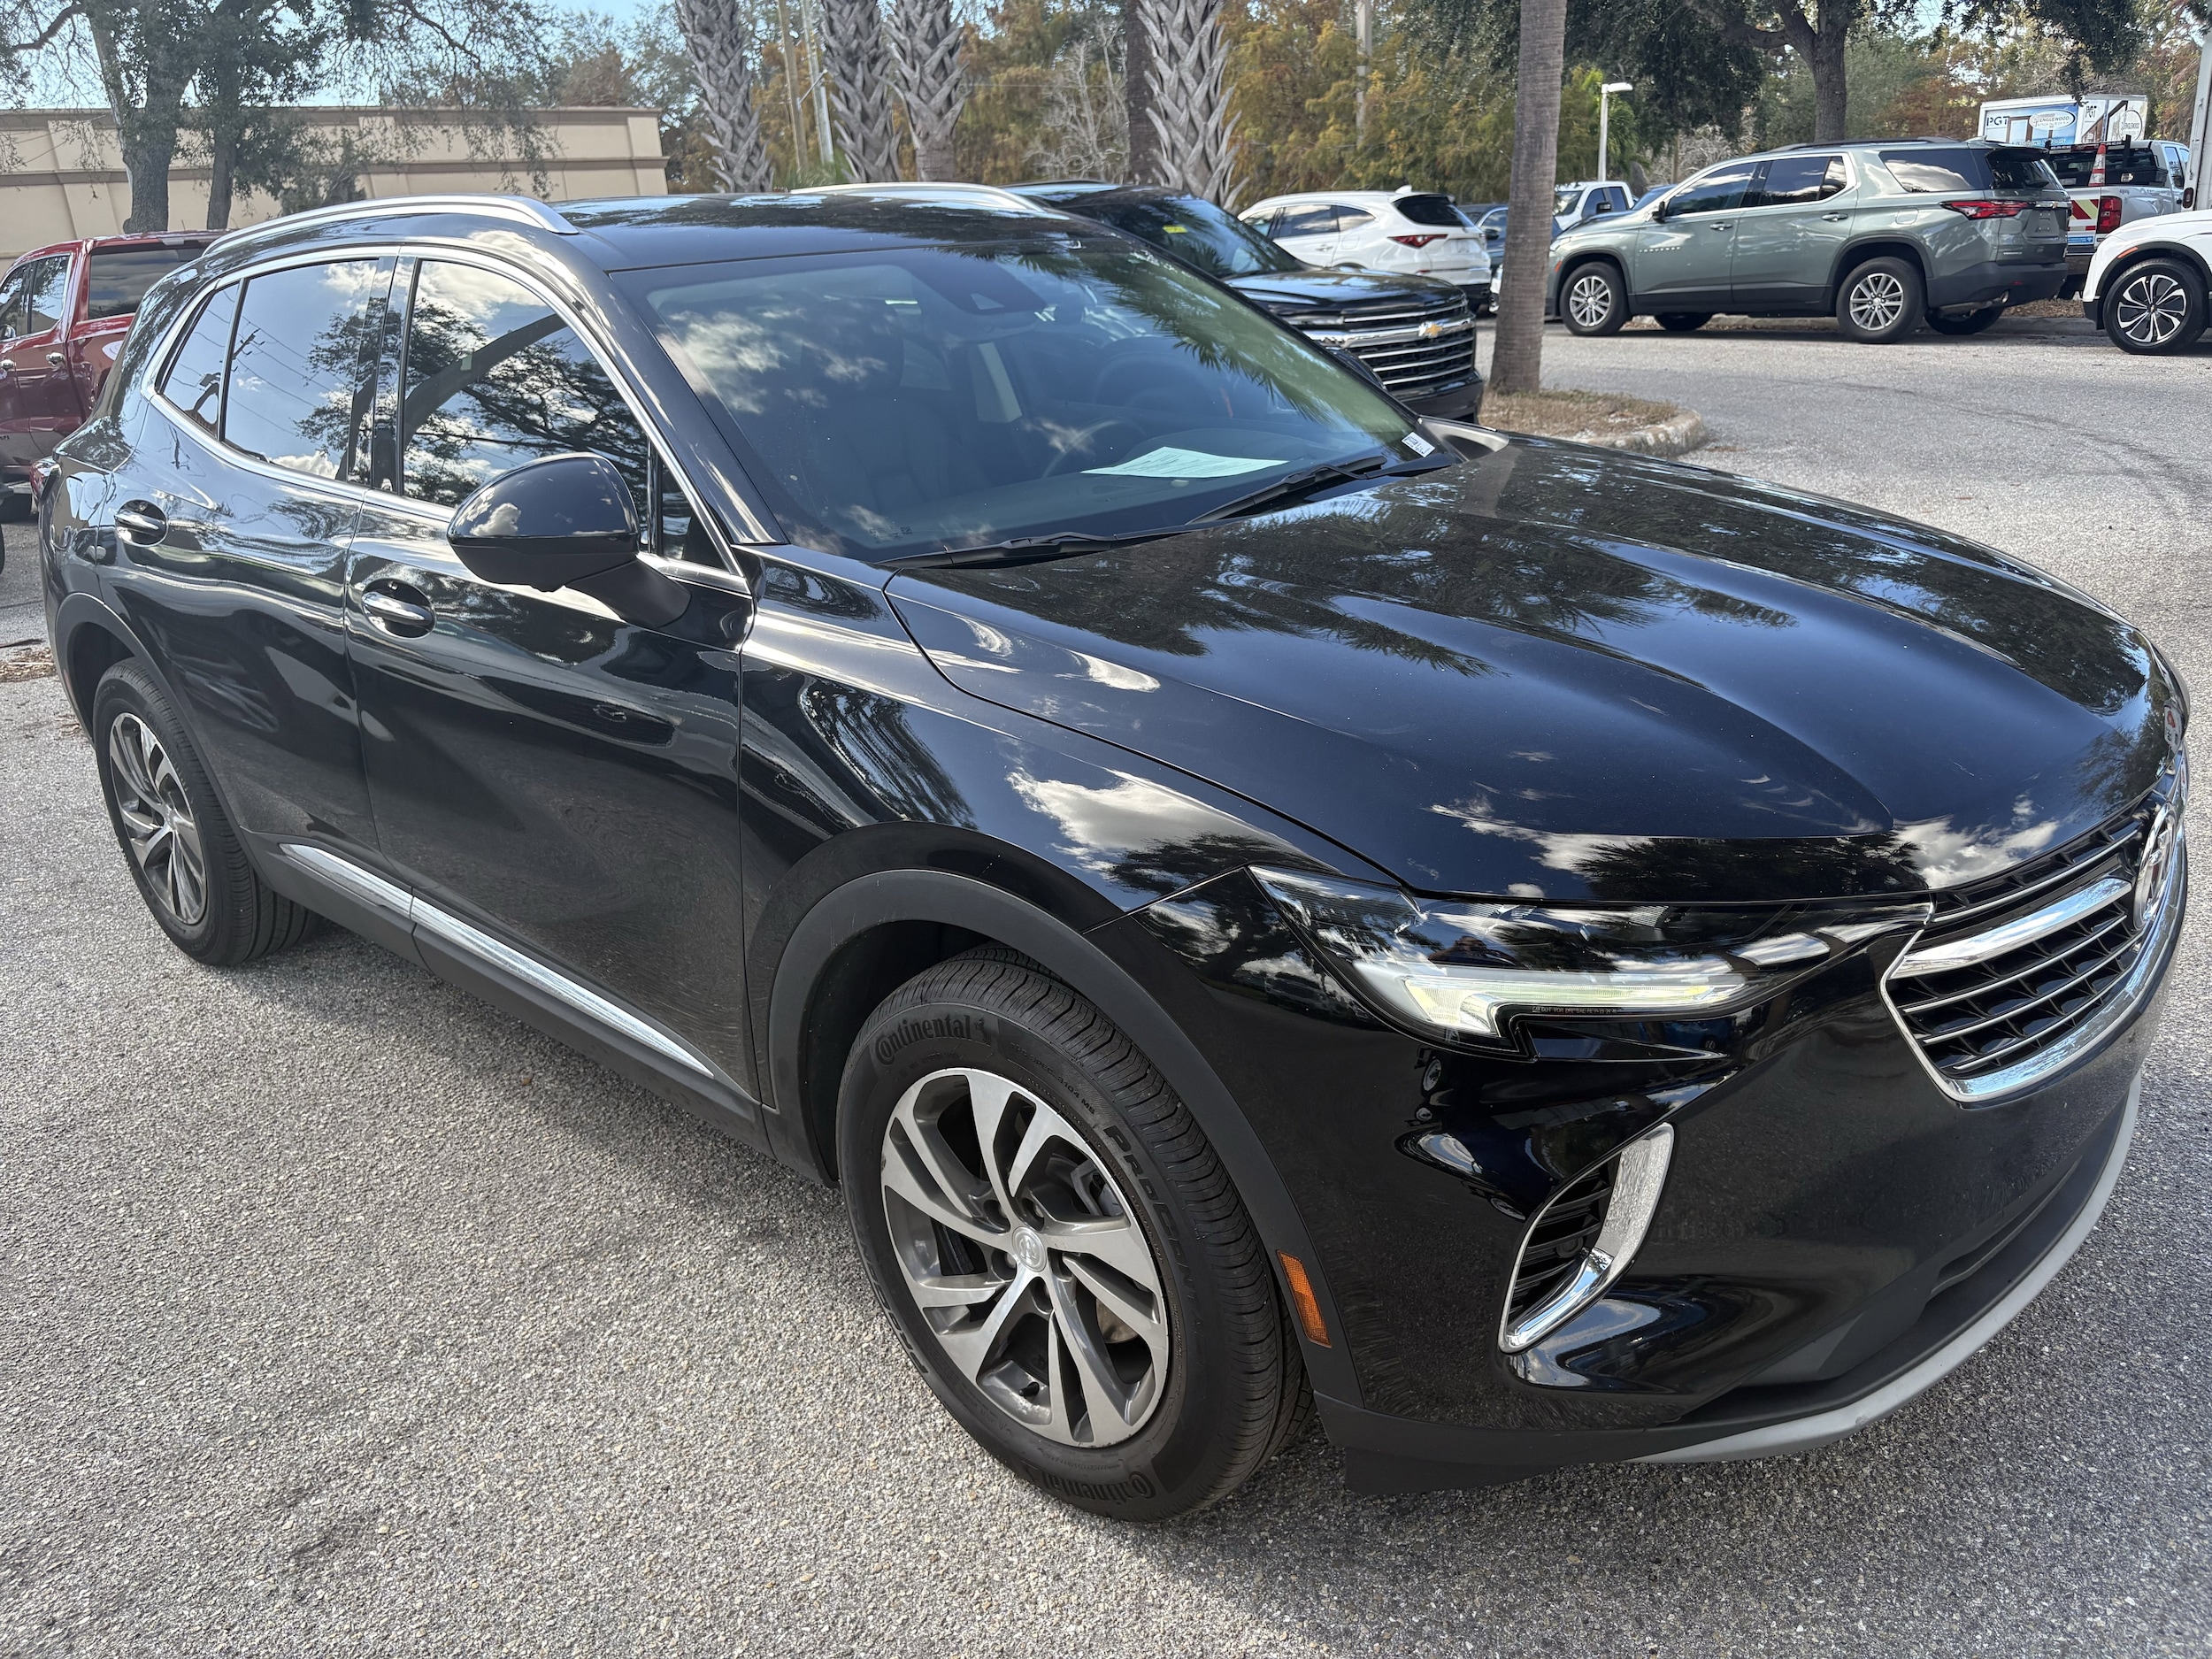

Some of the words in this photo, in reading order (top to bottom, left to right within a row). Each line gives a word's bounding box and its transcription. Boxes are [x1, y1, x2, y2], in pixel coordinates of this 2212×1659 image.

[1986, 116, 2009, 127] PGT
[874, 1014, 972, 1065] Continental
[1039, 1456, 1158, 1506] Continental
